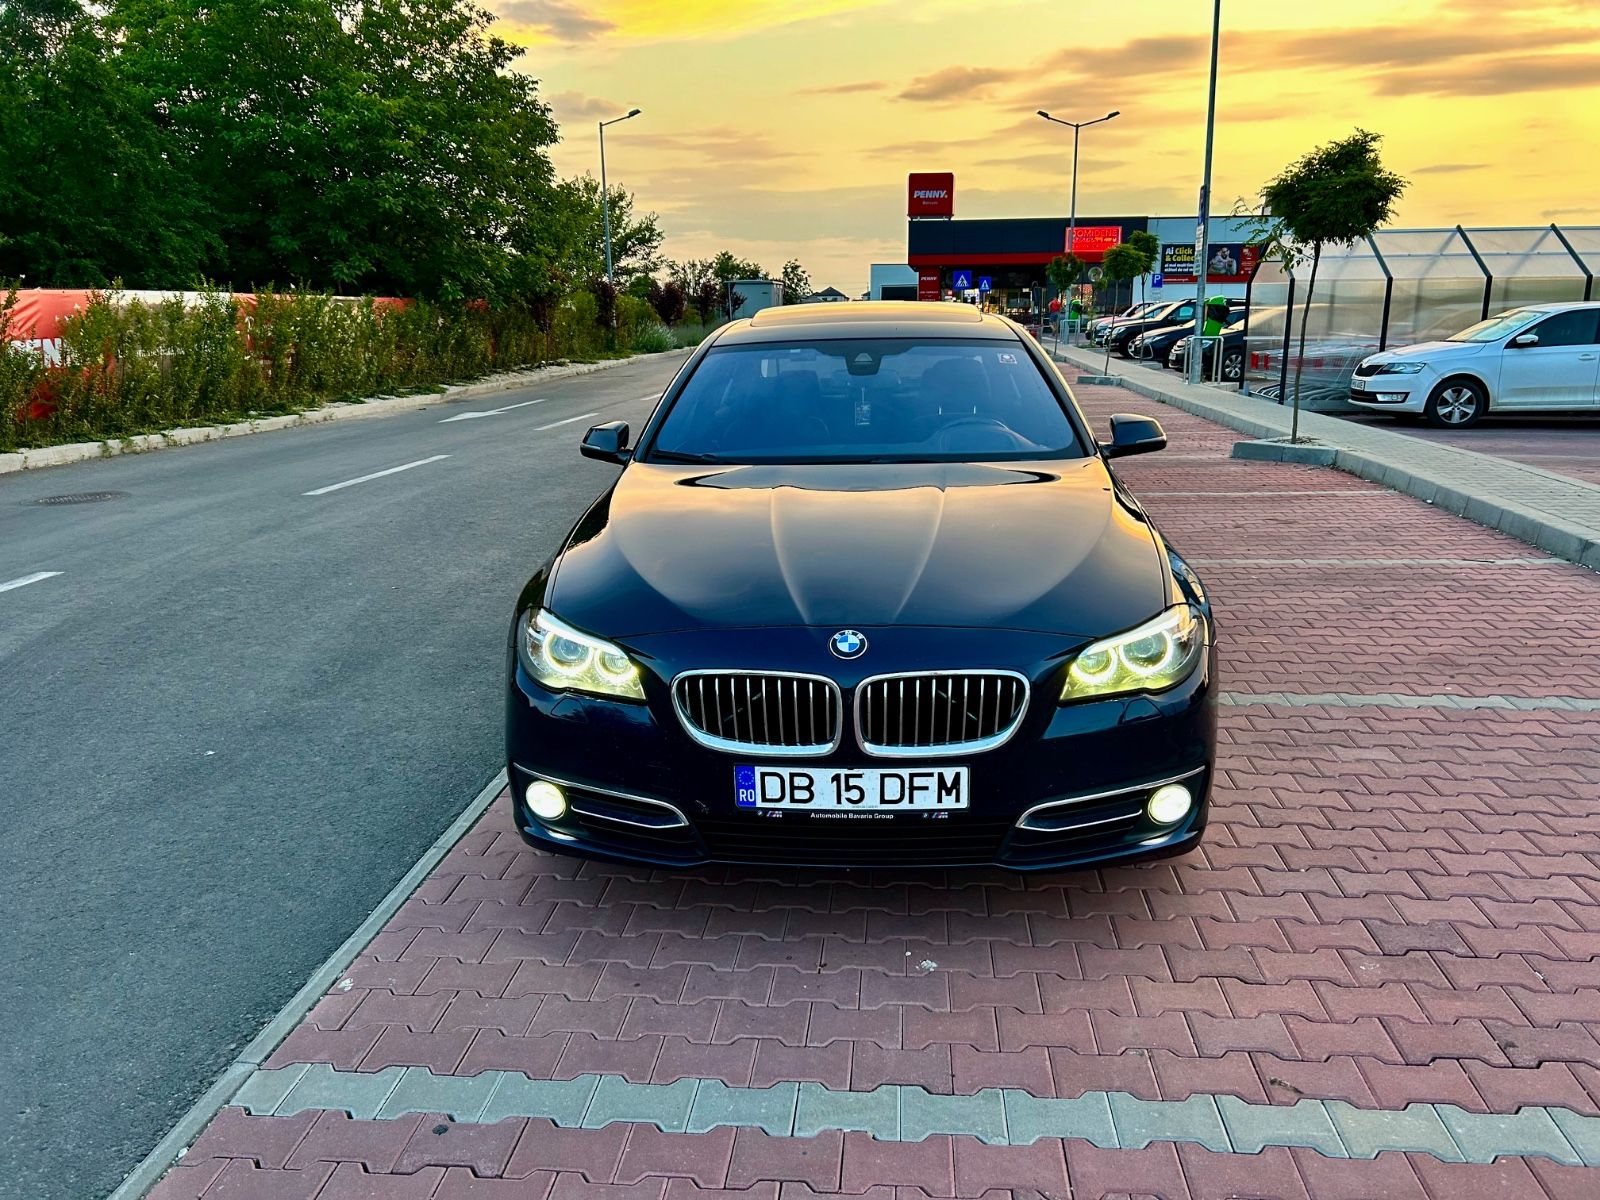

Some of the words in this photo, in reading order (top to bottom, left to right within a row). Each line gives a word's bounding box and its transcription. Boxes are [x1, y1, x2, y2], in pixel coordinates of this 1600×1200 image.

[1165, 247, 1174, 255] Ai
[1175, 246, 1193, 255] Click
[1154, 274, 1161, 284] P
[760, 772, 815, 804] DB
[831, 773, 865, 805] 15
[880, 772, 961, 805] DFM
[739, 789, 756, 802] RO
